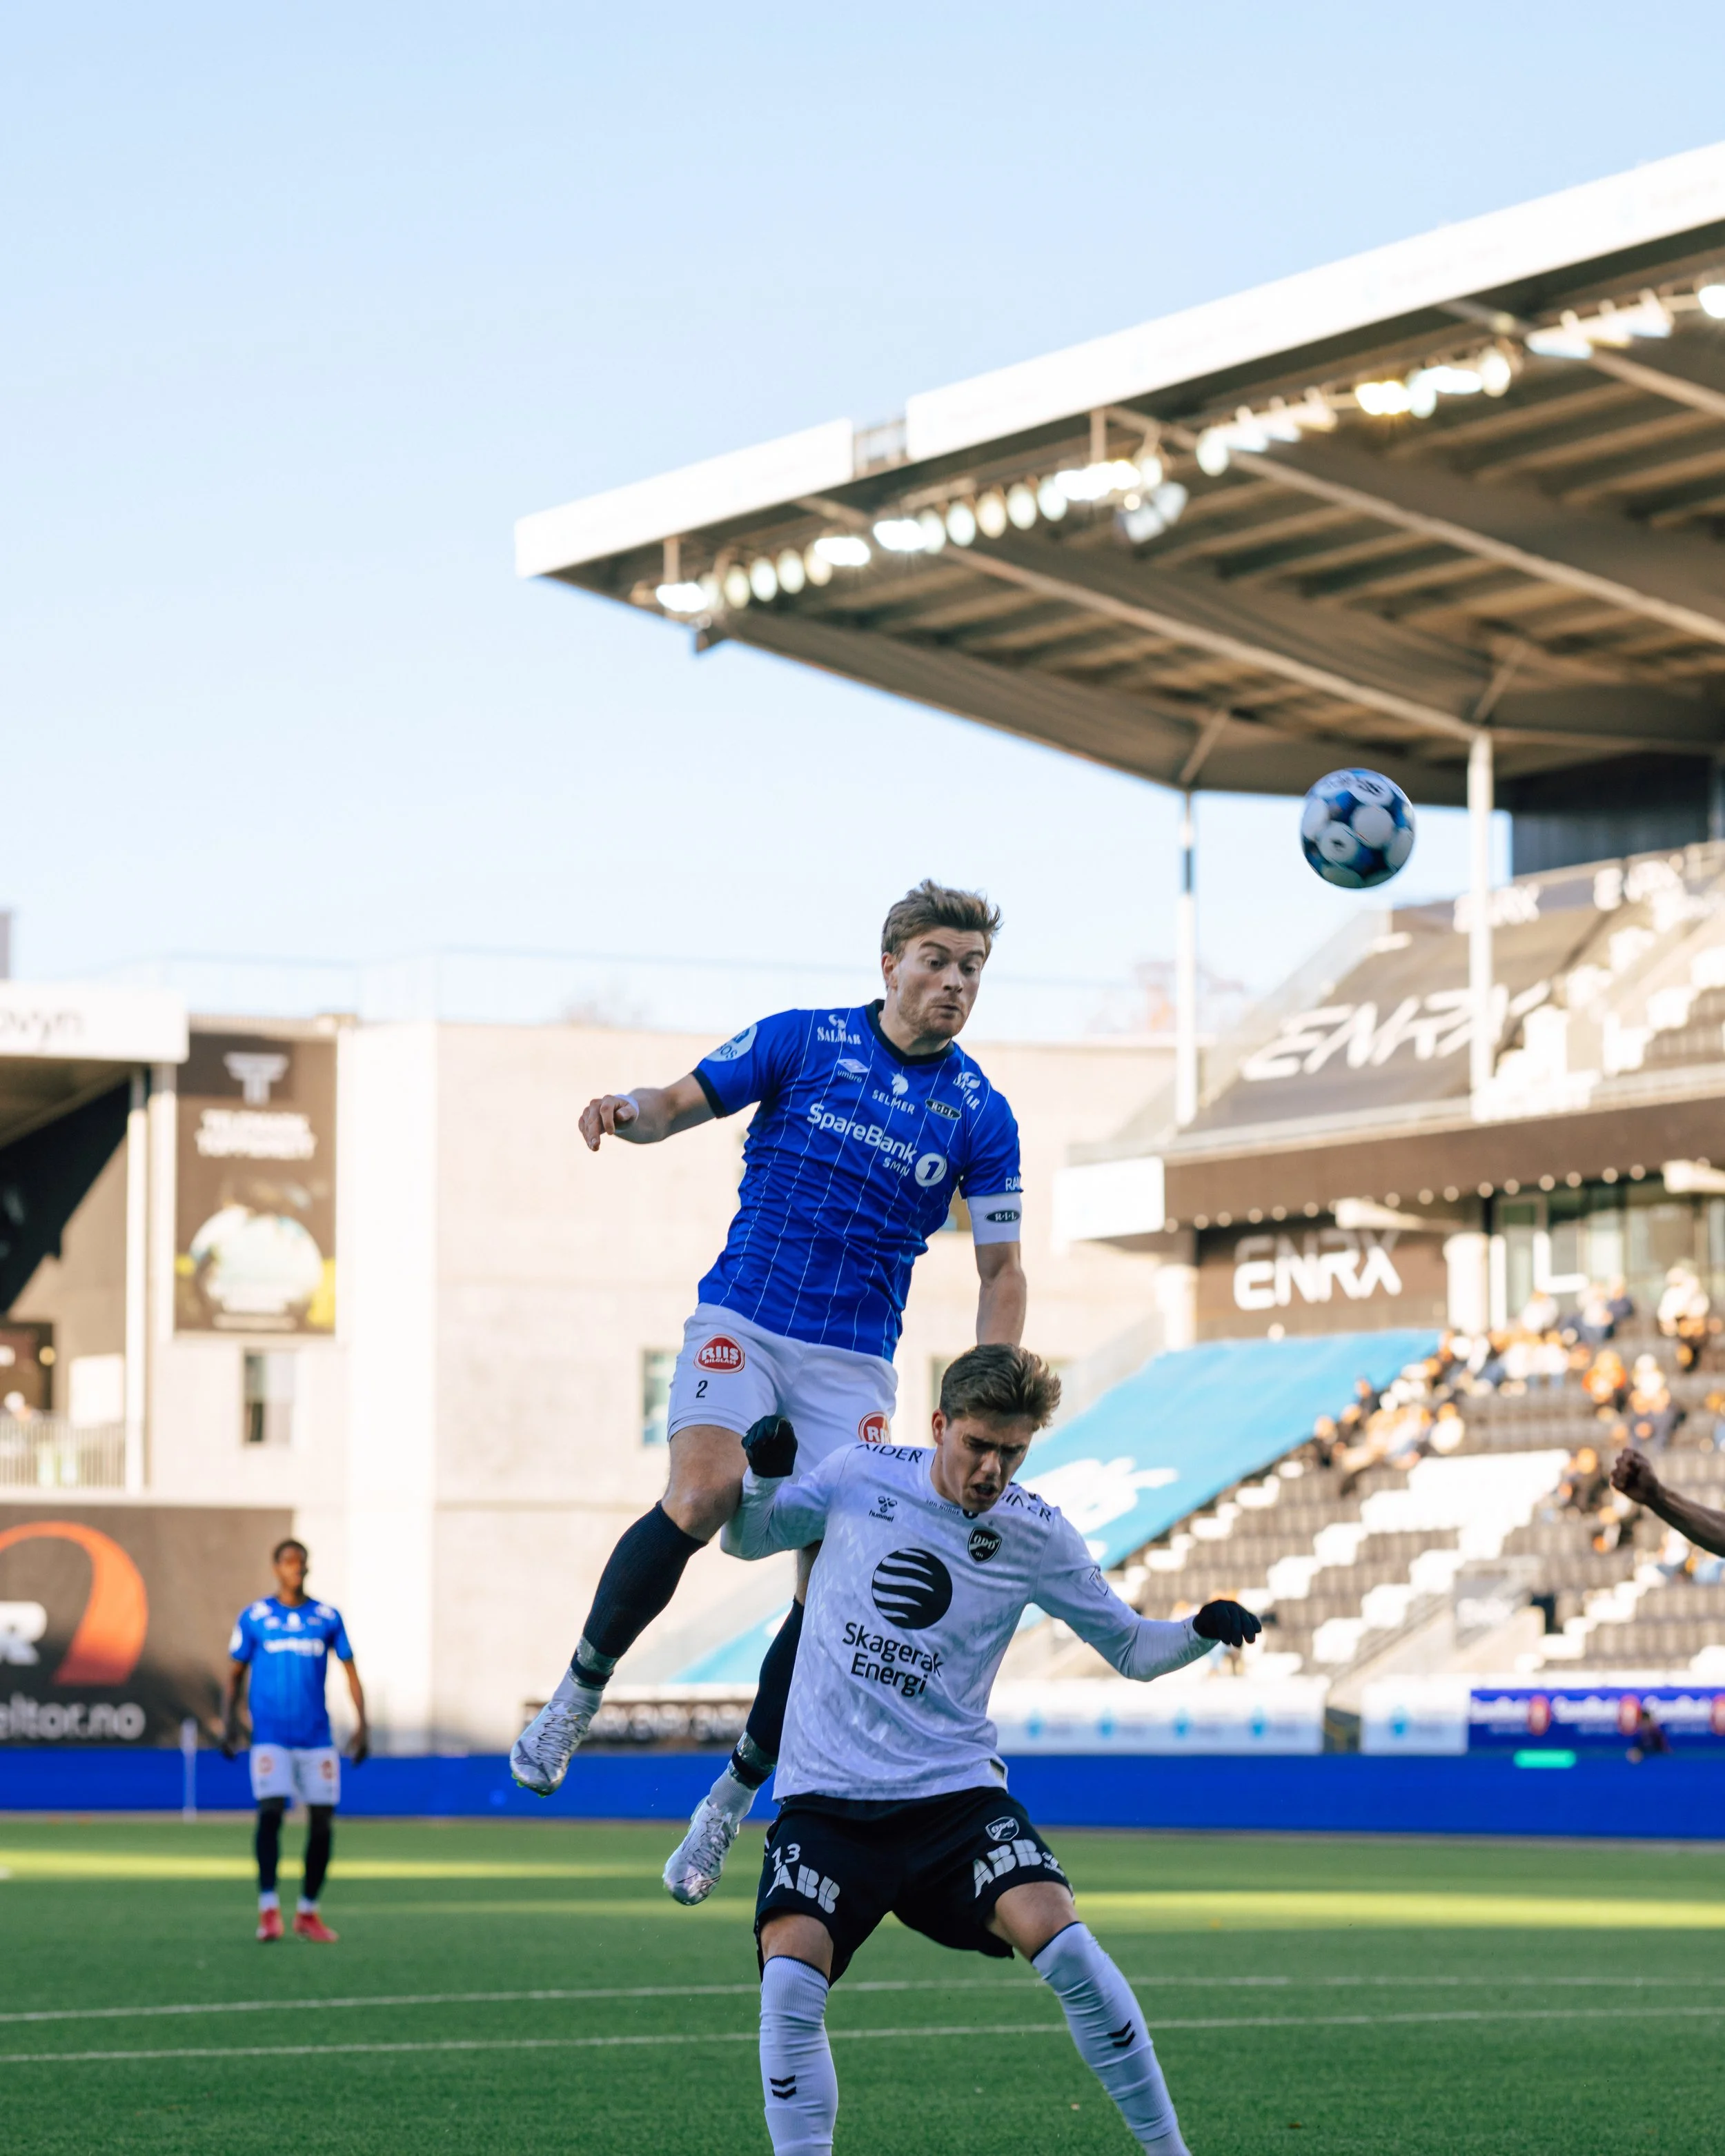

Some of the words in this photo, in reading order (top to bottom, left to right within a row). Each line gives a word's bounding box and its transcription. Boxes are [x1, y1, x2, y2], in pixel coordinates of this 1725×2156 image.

[837, 1069, 862, 1083] umbro
[871, 1089, 916, 1115] SELMER
[807, 1103, 917, 1164] SpareBank
[883, 1157, 910, 1177] SMN
[1234, 1245, 1403, 1311] ENRX
[701, 1345, 739, 1361] RIIS
[696, 1380, 708, 1399] 2
[869, 1510, 894, 1523] hummel
[842, 1622, 945, 1677] Skagerak
[851, 1652, 929, 1697] Energi
[771, 1843, 801, 1872] 13
[973, 1839, 1043, 1899] ABB
[765, 1864, 840, 1914] ABB
